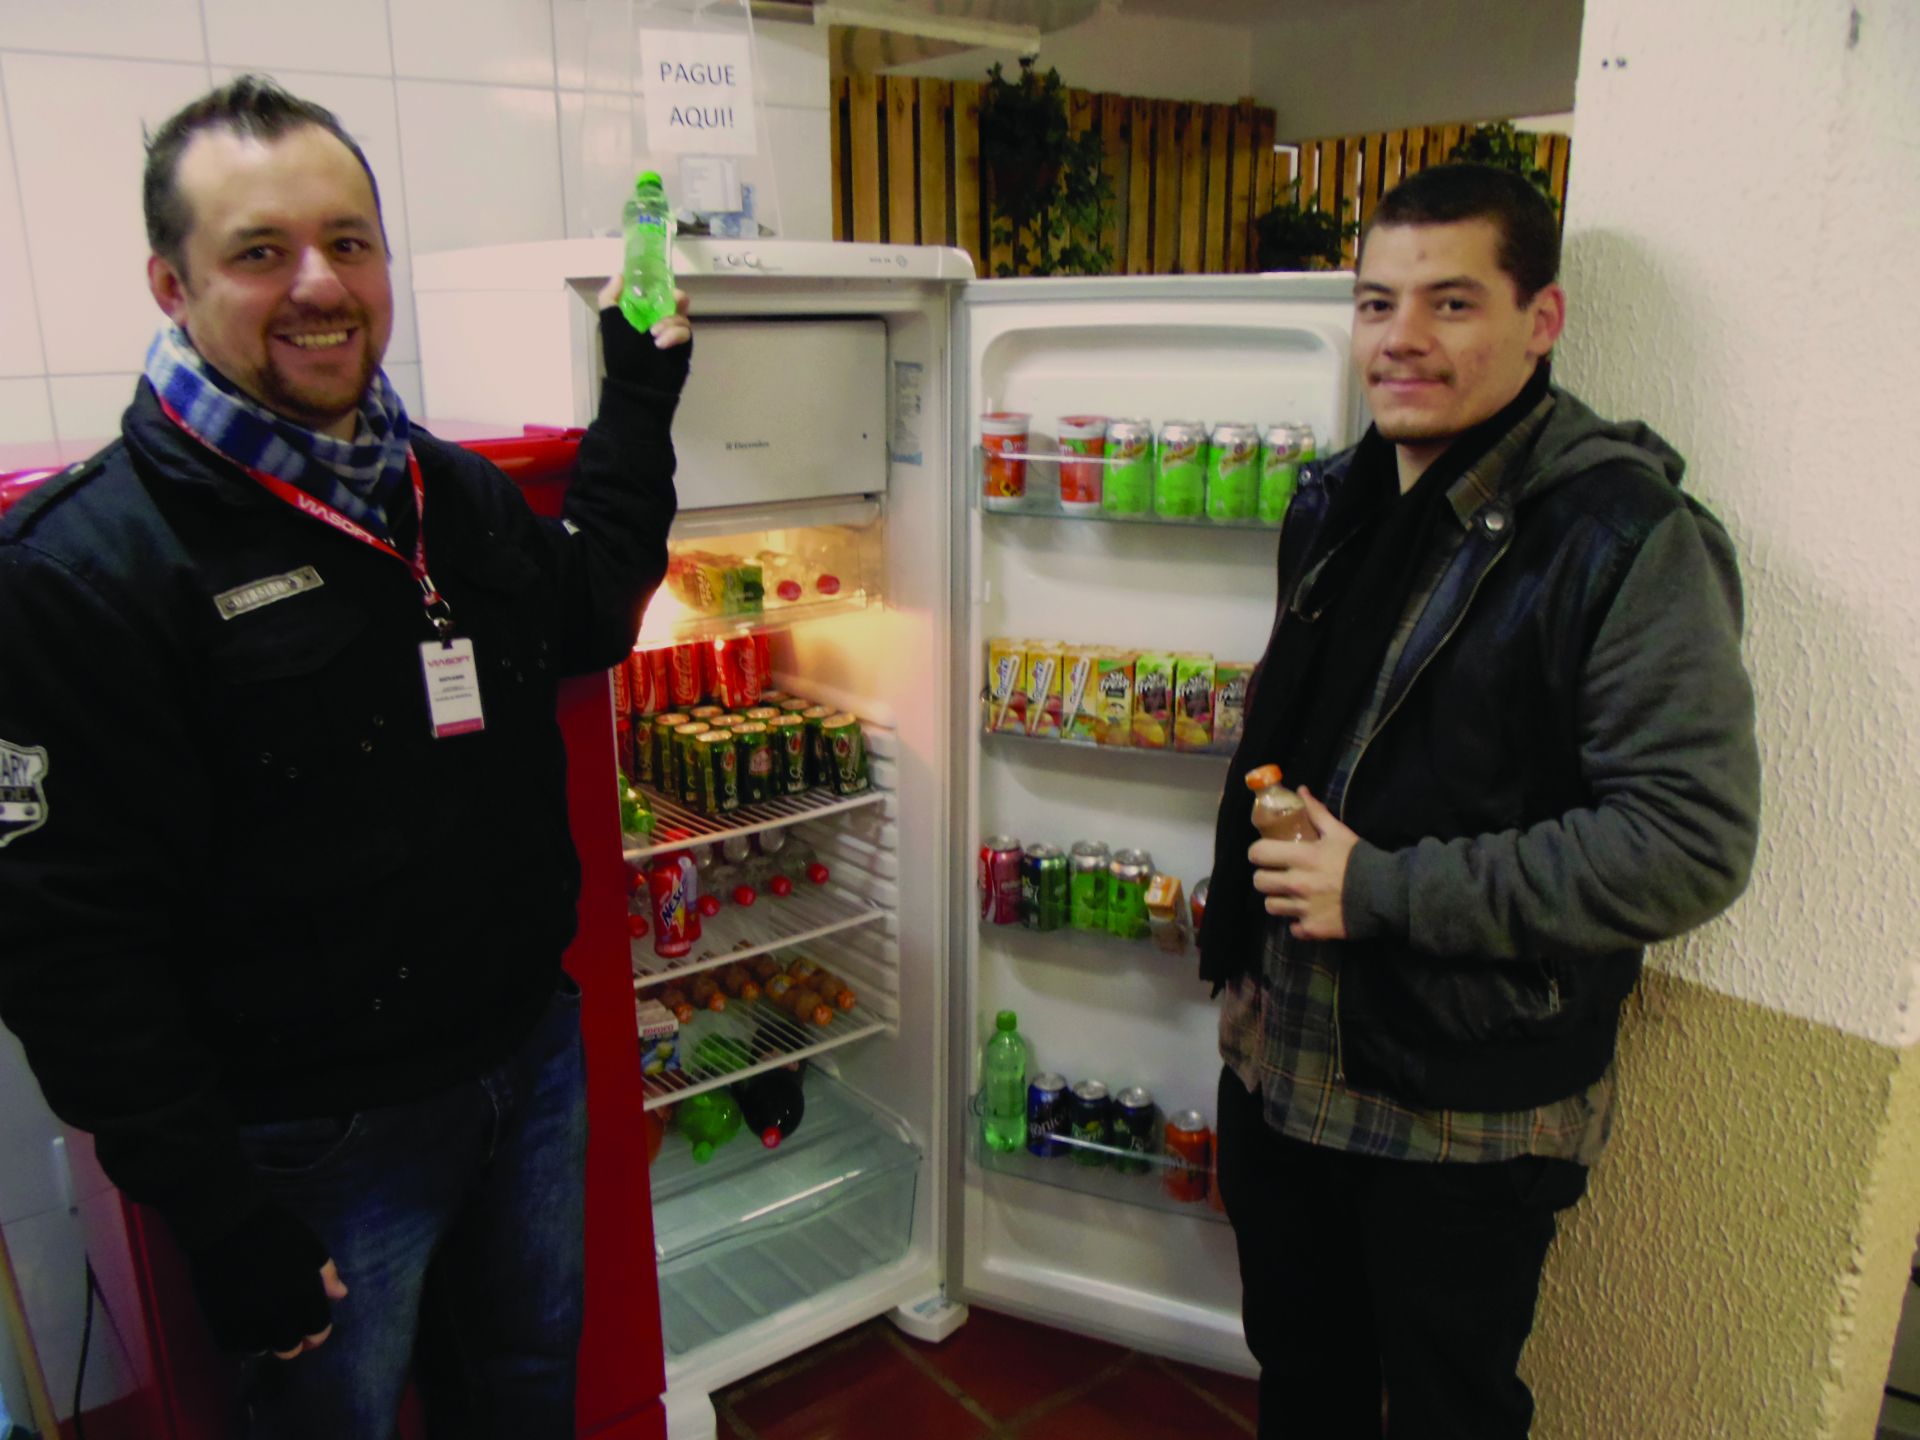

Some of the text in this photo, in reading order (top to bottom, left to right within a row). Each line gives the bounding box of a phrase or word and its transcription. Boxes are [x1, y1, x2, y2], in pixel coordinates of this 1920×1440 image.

[660, 62, 735, 86] PAGUE
[670, 106, 734, 129] AQUI!
[298, 493, 375, 543] VIASOFT
